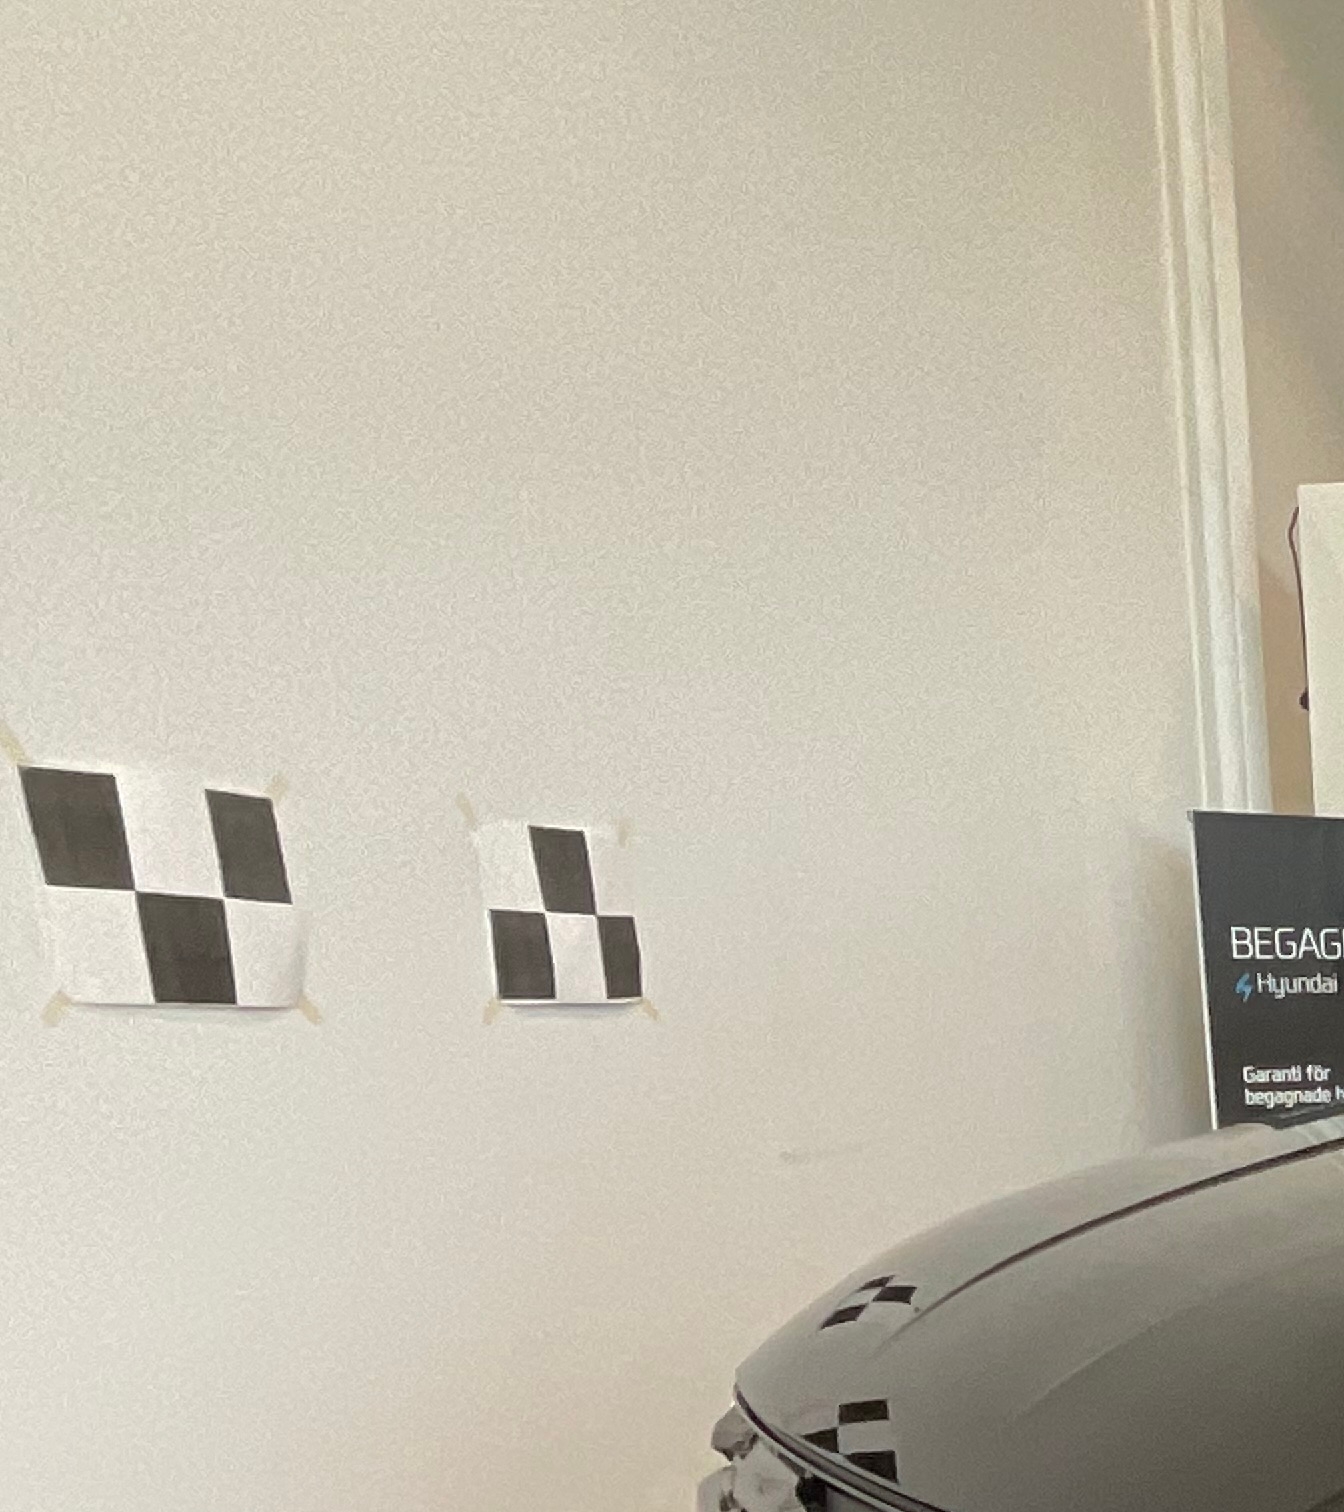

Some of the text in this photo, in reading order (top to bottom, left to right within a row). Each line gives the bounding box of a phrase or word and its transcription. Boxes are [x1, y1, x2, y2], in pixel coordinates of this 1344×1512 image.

[1256, 972, 1338, 999] Hyundai
[1243, 1064, 1332, 1084] Garanti för
[1245, 1086, 1332, 1109] begagnade
